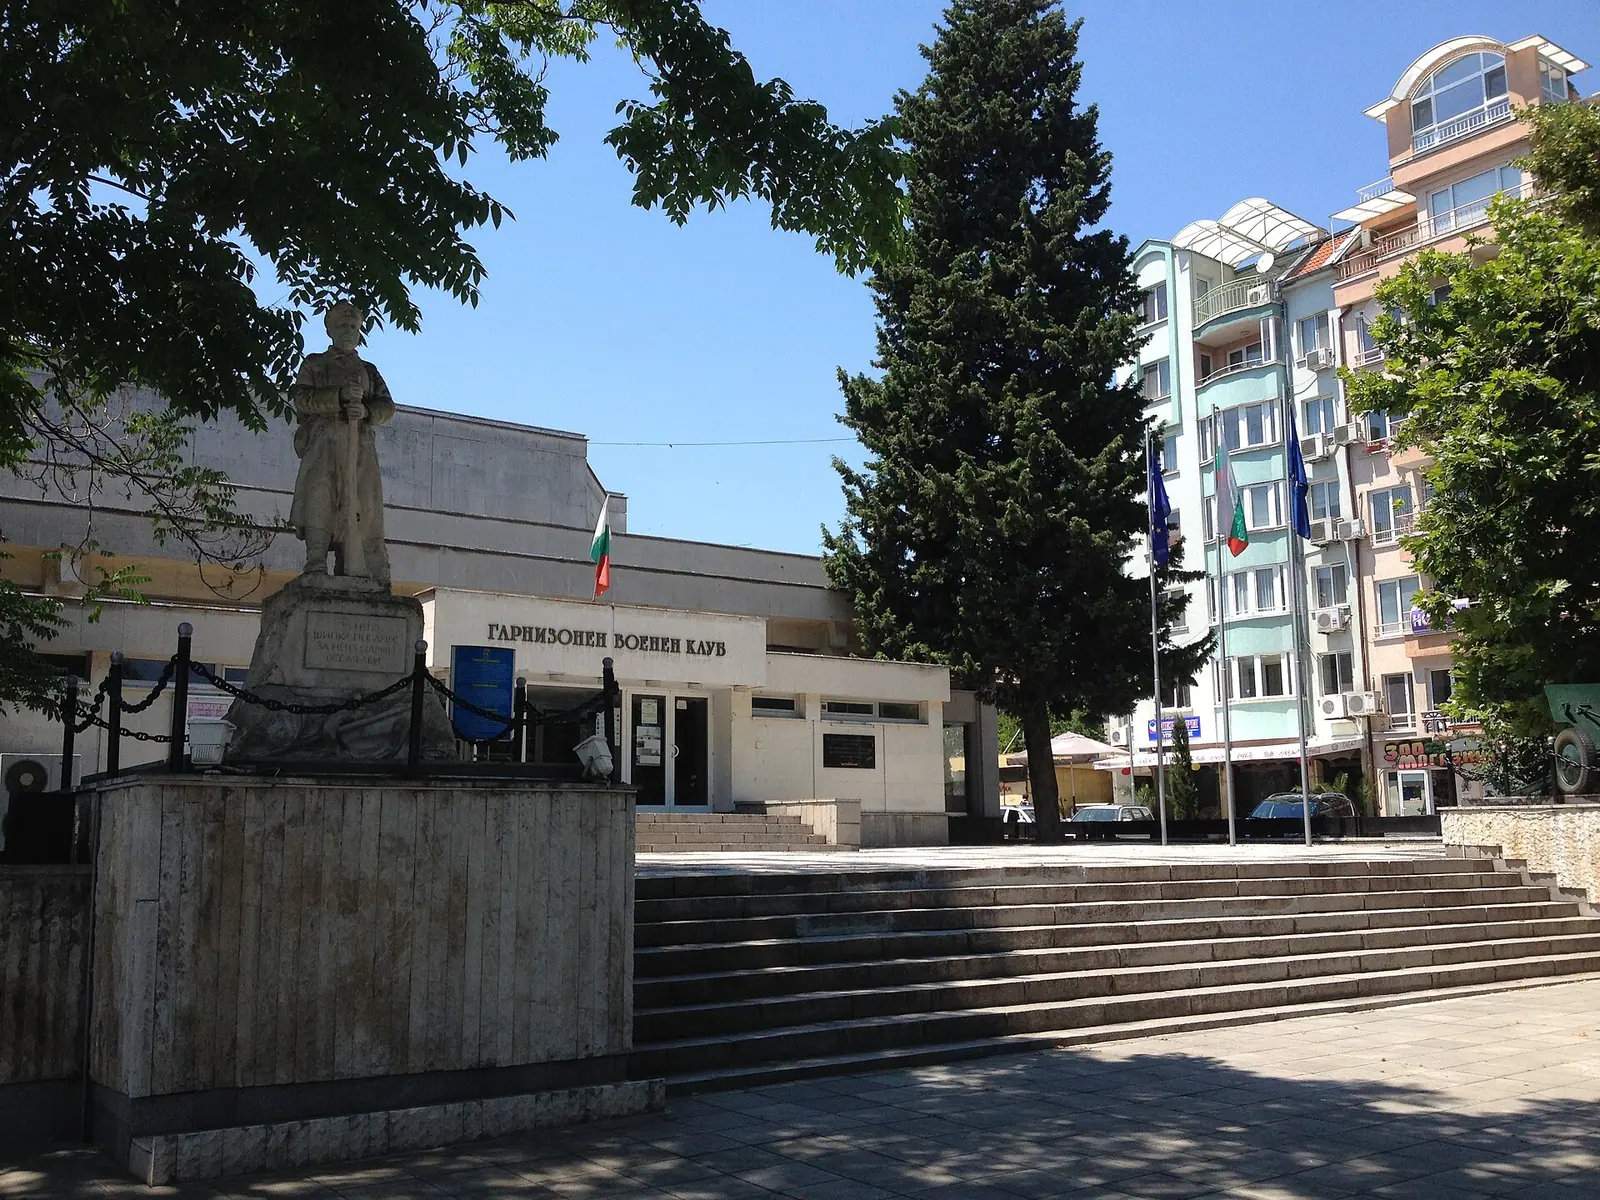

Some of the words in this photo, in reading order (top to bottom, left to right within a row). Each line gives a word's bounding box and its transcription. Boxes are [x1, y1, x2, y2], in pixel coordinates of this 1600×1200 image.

[487, 623, 608, 649] ГАРНИЗОНЕН
[613, 633, 682, 653] ВОЕНЕН
[685, 639, 727, 657] КЛУБ
[1384, 741, 1425, 761] ЗОО
